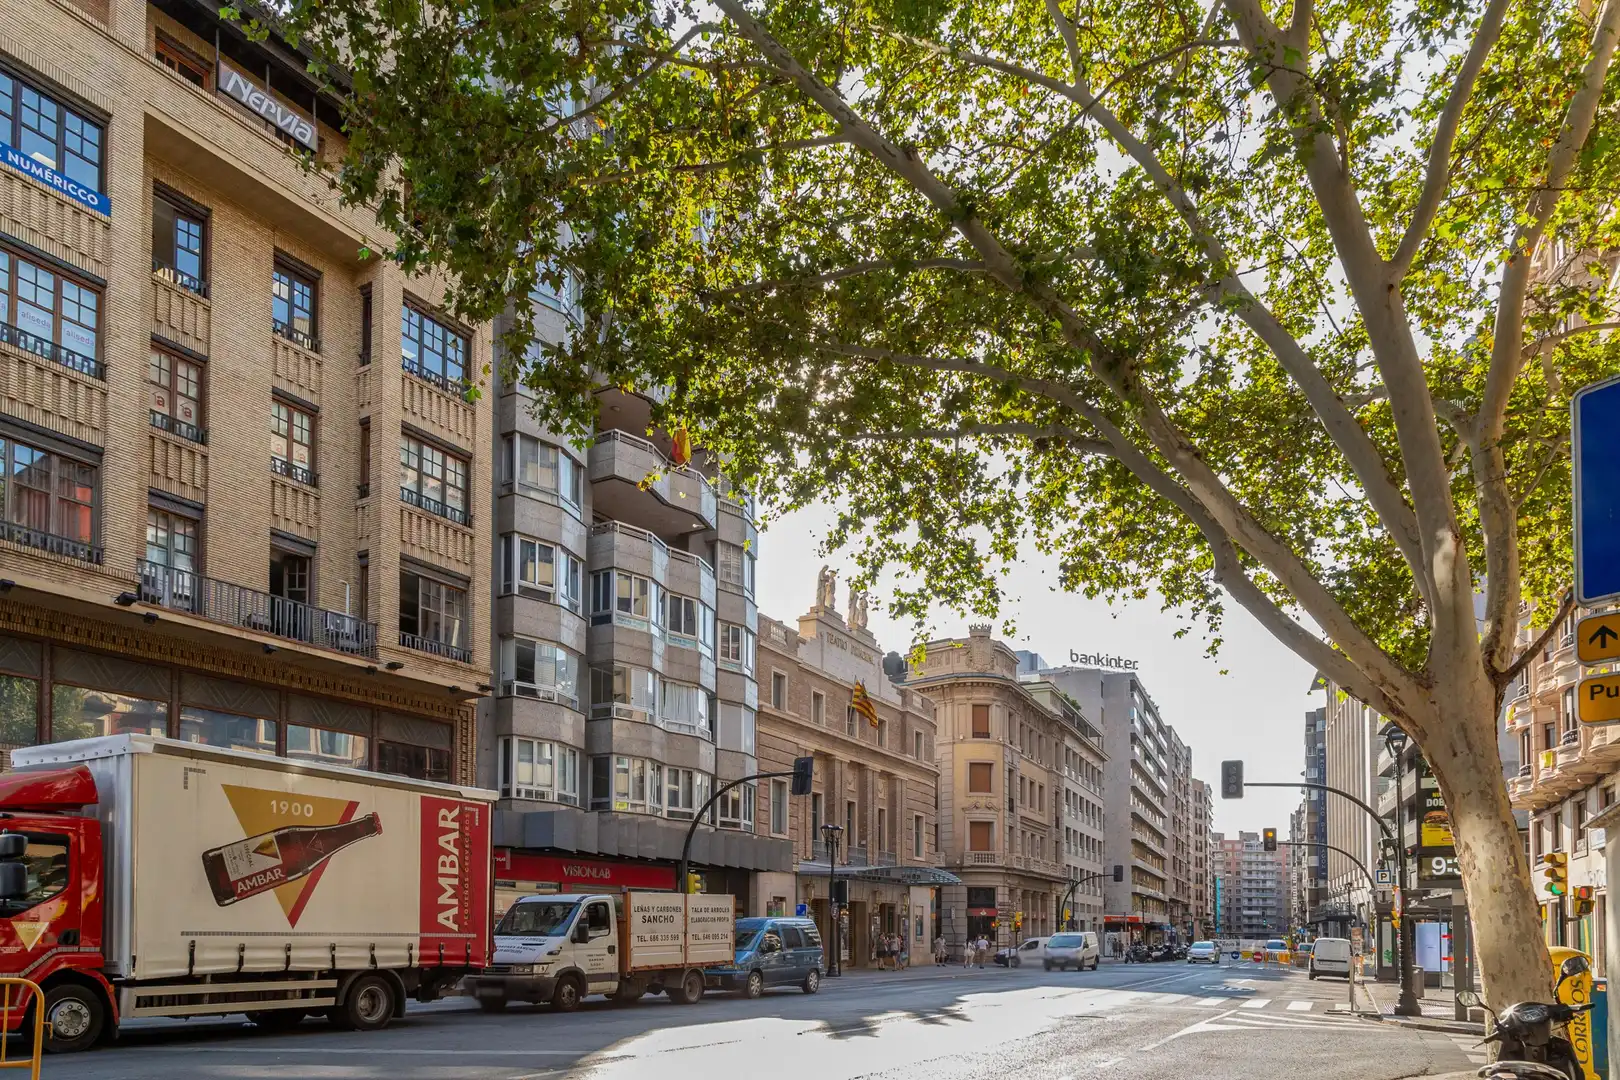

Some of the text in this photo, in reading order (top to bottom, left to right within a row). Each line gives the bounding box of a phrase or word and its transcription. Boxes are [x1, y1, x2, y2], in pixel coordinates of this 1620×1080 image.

[7, 150, 99, 206] NUMÉRICCO
[270, 800, 314, 817] 1900
[437, 804, 460, 932] AMBAR
[563, 865, 611, 879] VISIONLAB
[237, 867, 287, 894] AMBAR
[633, 905, 651, 913] LEÑAS
[656, 905, 682, 913] CARBONES
[641, 914, 675, 924] SANCHO
[636, 935, 649, 943] TEL.
[1571, 979, 1589, 1065] CORROS
